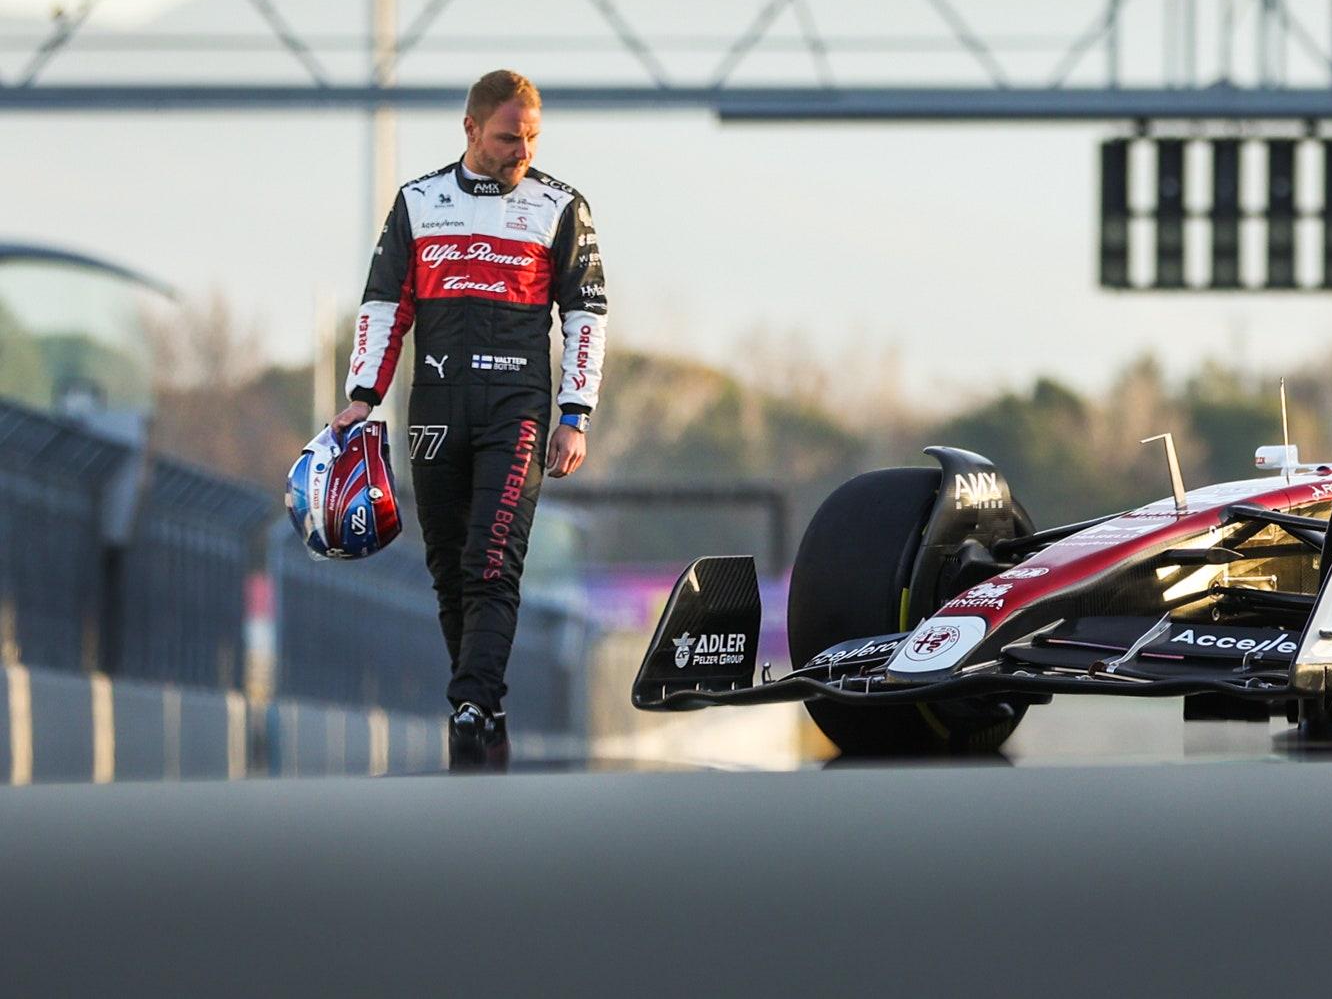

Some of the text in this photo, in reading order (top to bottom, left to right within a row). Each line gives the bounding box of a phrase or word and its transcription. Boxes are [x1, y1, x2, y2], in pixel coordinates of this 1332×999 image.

[473, 183, 500, 191] AMX
[421, 242, 535, 269] Alfa Romeo
[442, 275, 508, 293] Tonale
[358, 315, 370, 356] ORLEN
[577, 325, 591, 369] ORLEN
[409, 425, 448, 460] 77
[483, 420, 537, 582] VALTTERI BOTTAS
[694, 633, 746, 653] ADLER
[1170, 629, 1298, 654] Accelle
[692, 653, 745, 666] PELZER GROUP
